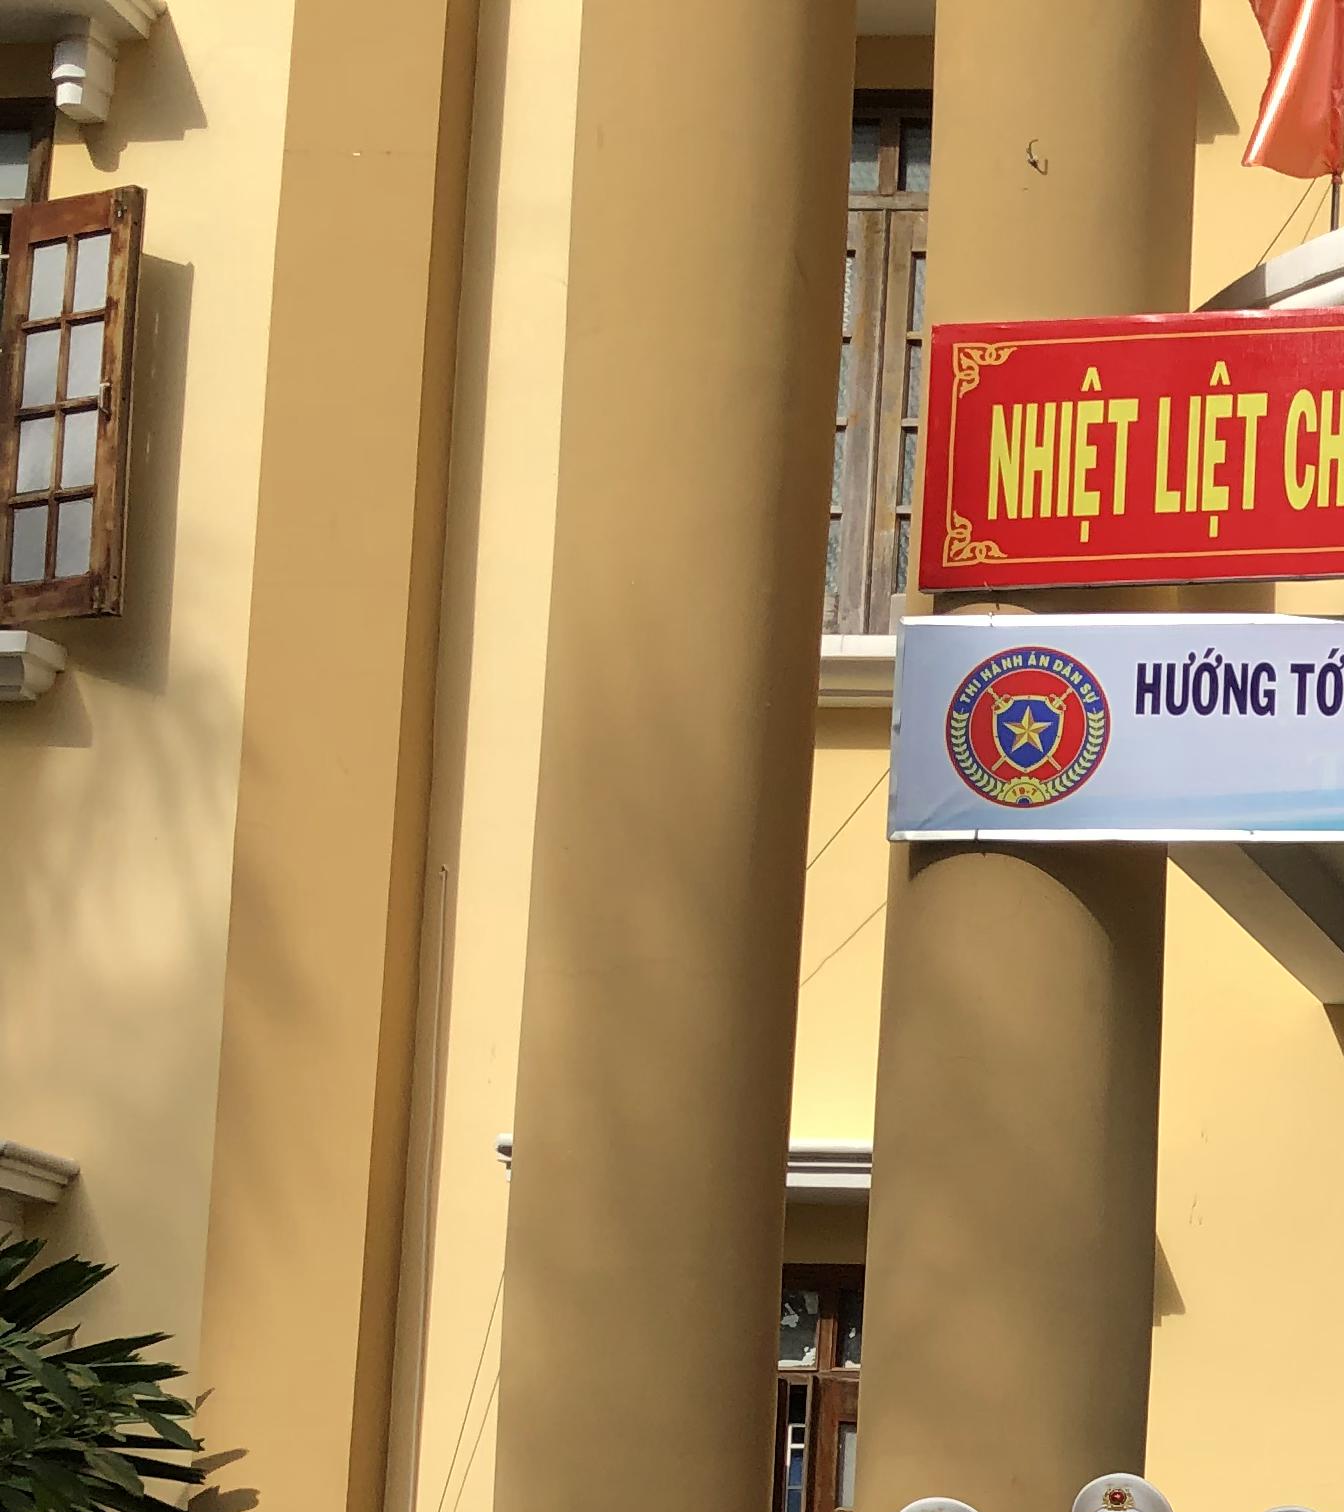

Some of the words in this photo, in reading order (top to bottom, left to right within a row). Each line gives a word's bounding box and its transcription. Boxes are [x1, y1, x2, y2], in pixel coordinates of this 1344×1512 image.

[989, 366, 1137, 541] NHIỆT
[1156, 361, 1267, 537] LIỆT
[960, 679, 982, 704] THI
[1027, 651, 1050, 667] ÁN
[1052, 659, 1083, 685] DÂN
[1135, 647, 1276, 716] HƯỚNG
